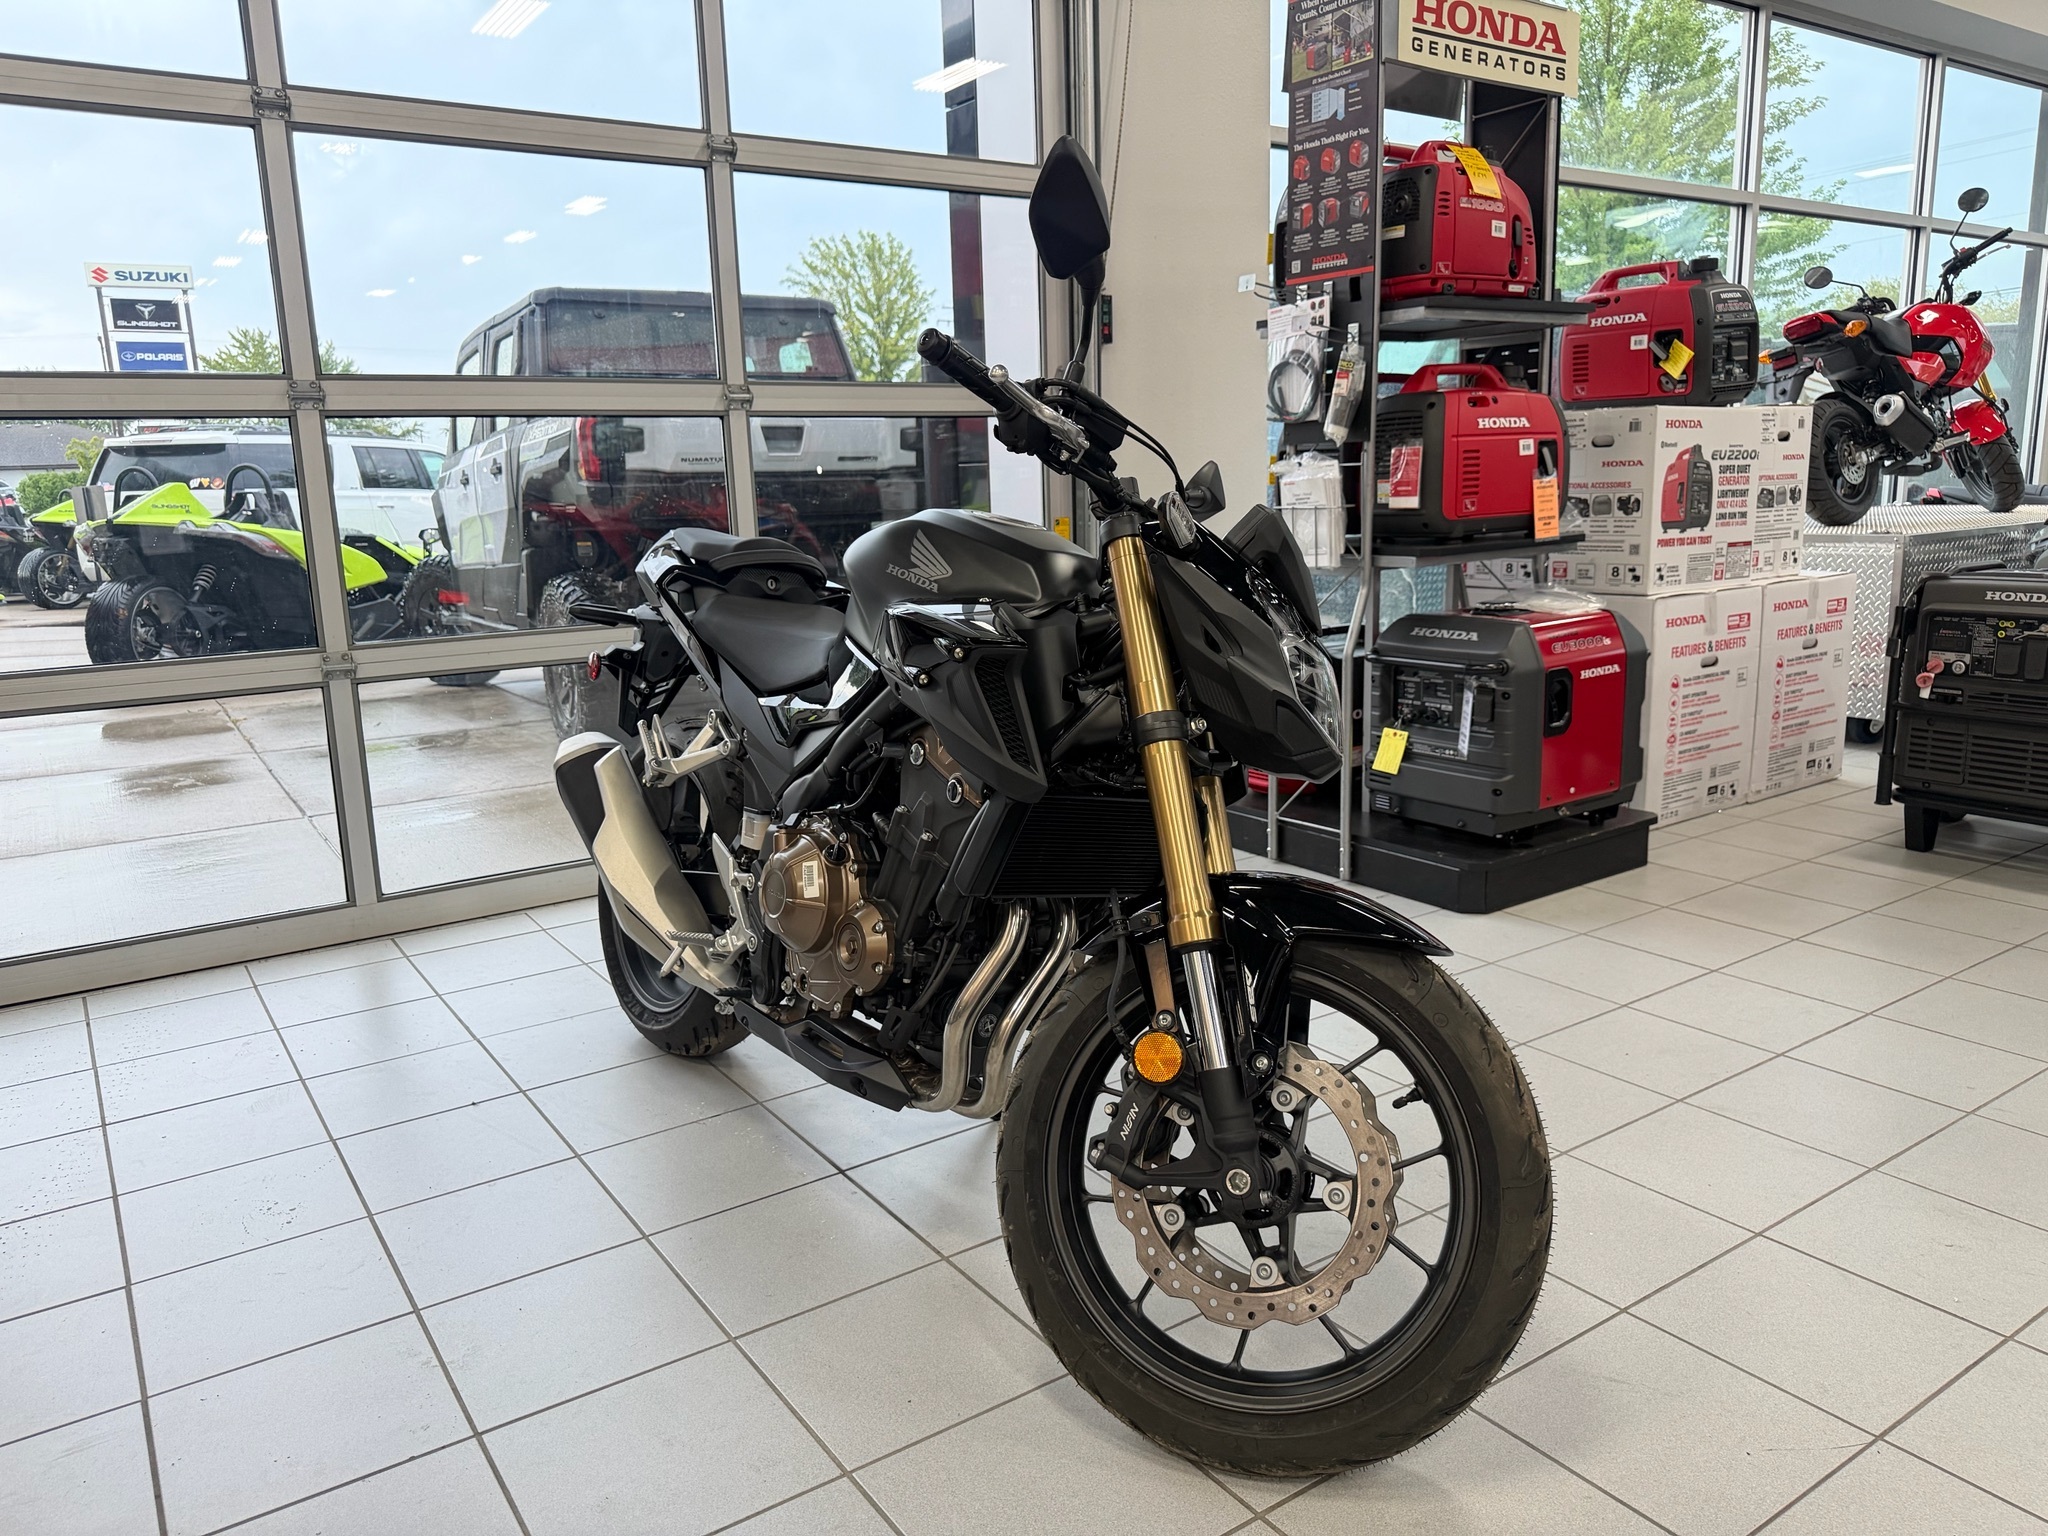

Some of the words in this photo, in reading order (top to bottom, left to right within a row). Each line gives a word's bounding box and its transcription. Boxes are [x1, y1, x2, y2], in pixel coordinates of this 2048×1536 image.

[1319, 1, 1337, 14] Count
[1412, 0, 1566, 56] HONDA
[1412, 36, 1566, 81] GENERATORS
[1294, 143, 1303, 152] The
[1303, 140, 1321, 150] Honda
[1335, 132, 1349, 142] Right
[1349, 129, 1358, 138] For
[1312, 252, 1348, 265] HONDA
[114, 270, 189, 283] SUZUKI
[116, 320, 178, 328] SLINGSHOT
[1590, 312, 1648, 328] HONDA
[136, 352, 184, 361] POLARIS
[1477, 416, 1531, 429] HONDA
[1665, 419, 1703, 429] HONDA
[1711, 449, 1760, 461] EU2200i
[1601, 459, 1644, 468] HONDA
[1719, 464, 1736, 474] SUPER
[1590, 481, 1632, 489] ACCESSORIES
[1718, 475, 1750, 486] GENERATOR
[1717, 488, 1750, 499] LIGHTWEIGHT
[1717, 500, 1729, 509] ONLY
[1657, 538, 1675, 548] POWER
[1676, 537, 1686, 547] YOU
[1686, 536, 1697, 546] CAN
[1697, 535, 1713, 545] TRUST
[1782, 551, 1788, 562] 8
[1506, 562, 1513, 574] 8
[1611, 566, 1620, 577] 8
[885, 562, 939, 593] HONDA
[1985, 590, 2048, 603] HOND
[1773, 598, 1809, 612] HONDA
[1665, 614, 1706, 629] HONDA
[1410, 626, 1479, 642] HONDA
[1777, 625, 1808, 641] FEATURES
[1808, 623, 1814, 635] &
[1814, 619, 1843, 634] BENEFITS
[1551, 635, 1612, 654] EU3000is
[1671, 642, 1707, 659] FEATURES
[1707, 640, 1713, 653] &
[1714, 636, 1747, 652] BENEFITS
[1580, 664, 1621, 680] HONDA
